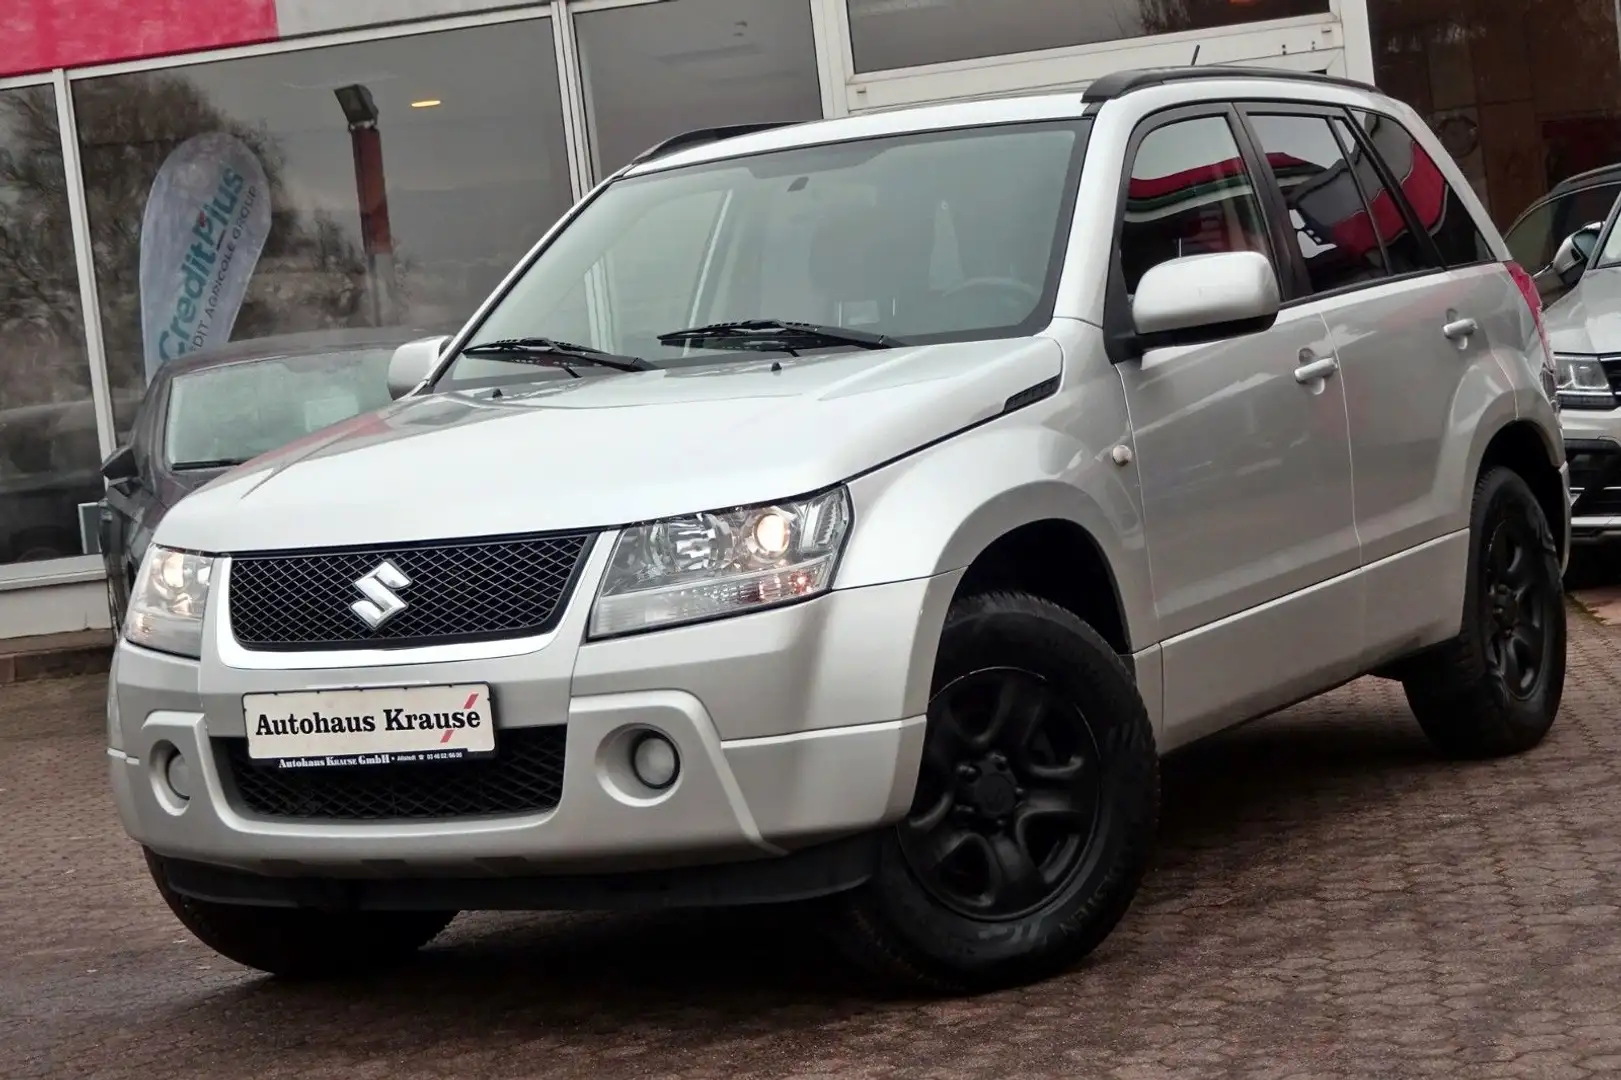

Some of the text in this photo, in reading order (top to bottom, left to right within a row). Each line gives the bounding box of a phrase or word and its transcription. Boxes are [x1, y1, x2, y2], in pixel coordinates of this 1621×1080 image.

[158, 167, 244, 362] CreditPlus
[203, 243, 236, 319] AGRICOLE
[233, 185, 259, 239] GROUP
[256, 708, 480, 736] Autohaus Krause
[279, 758, 325, 769] Autohaus
[358, 754, 390, 765] GmbH
